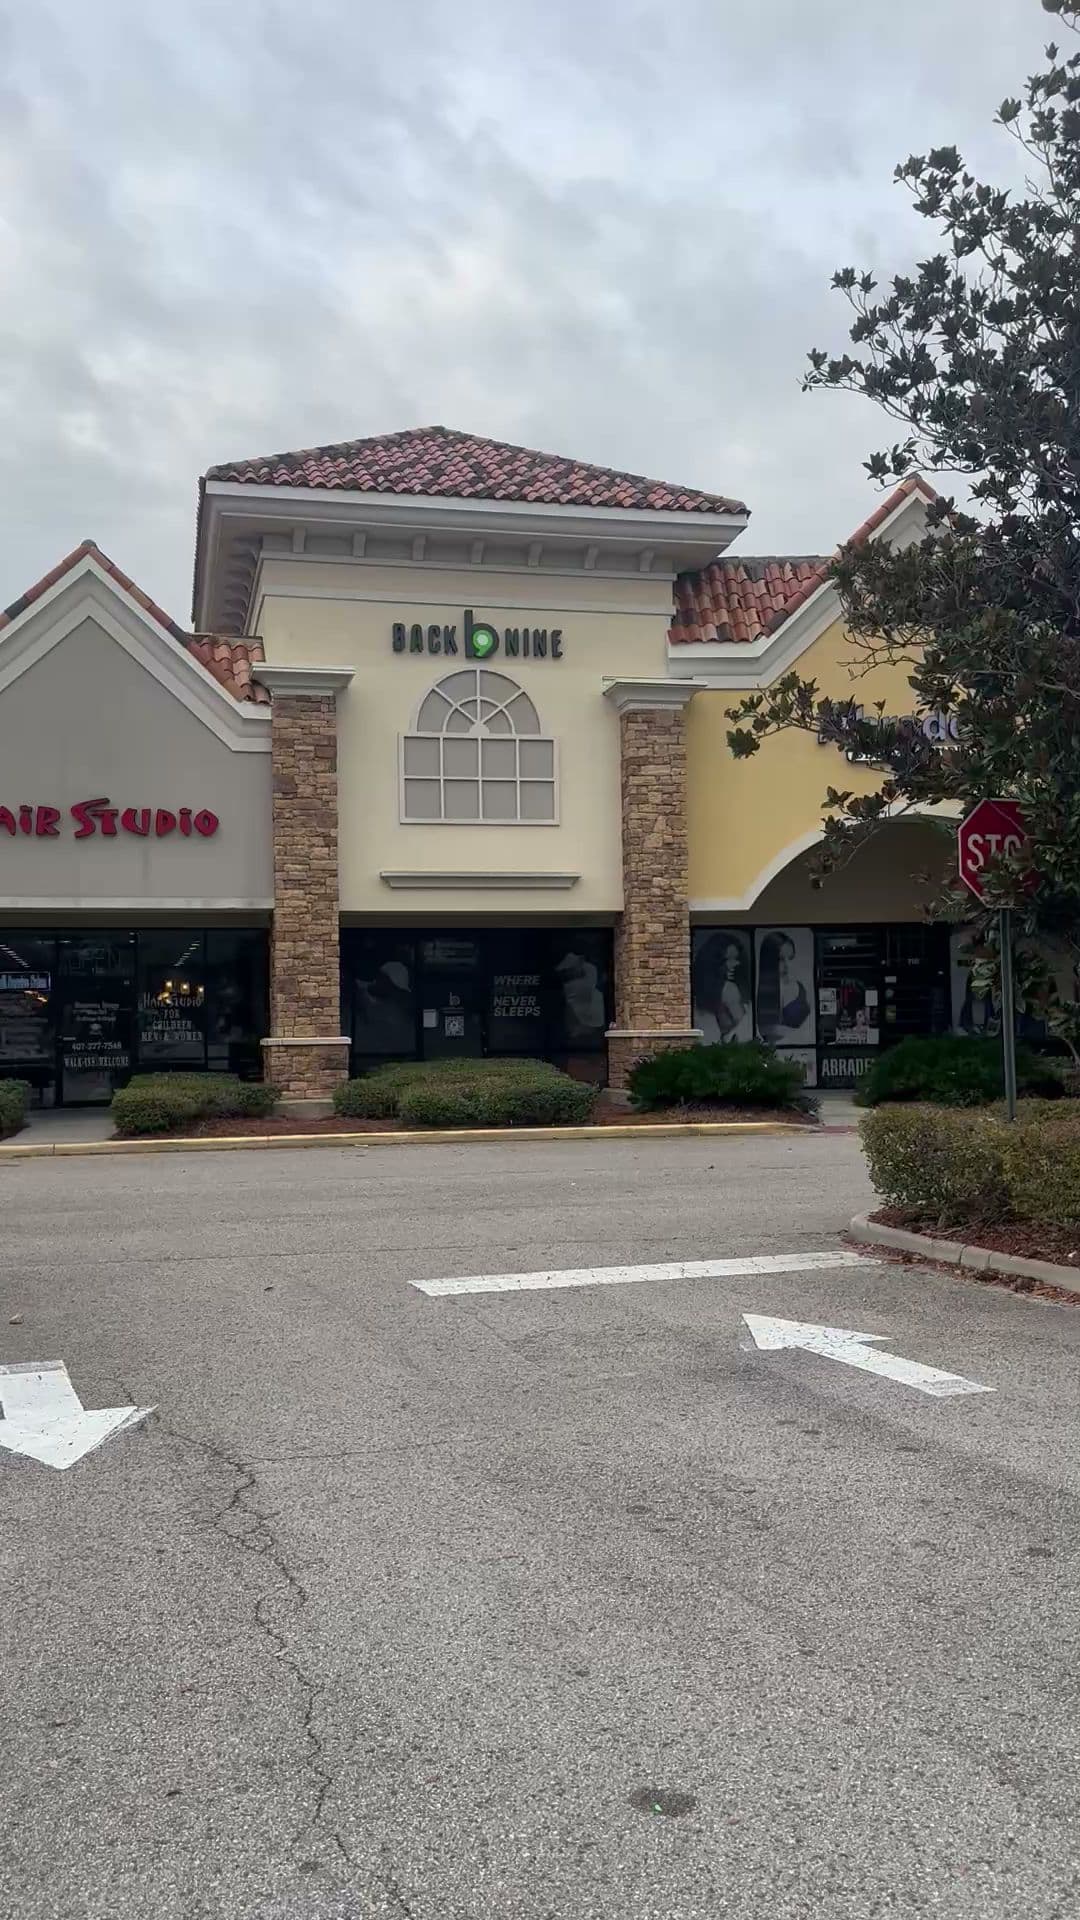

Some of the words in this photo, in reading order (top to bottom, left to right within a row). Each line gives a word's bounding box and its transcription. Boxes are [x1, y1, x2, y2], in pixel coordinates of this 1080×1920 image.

[392, 623, 458, 654] BACK
[505, 628, 563, 658] NINE
[71, 798, 219, 838] STUDIO
[967, 834, 1022, 872] STO
[494, 975, 541, 985] WHERE
[494, 996, 537, 1007] NEVER
[494, 1007, 541, 1017] SLEEPS
[822, 1058, 876, 1077] ABRADE
